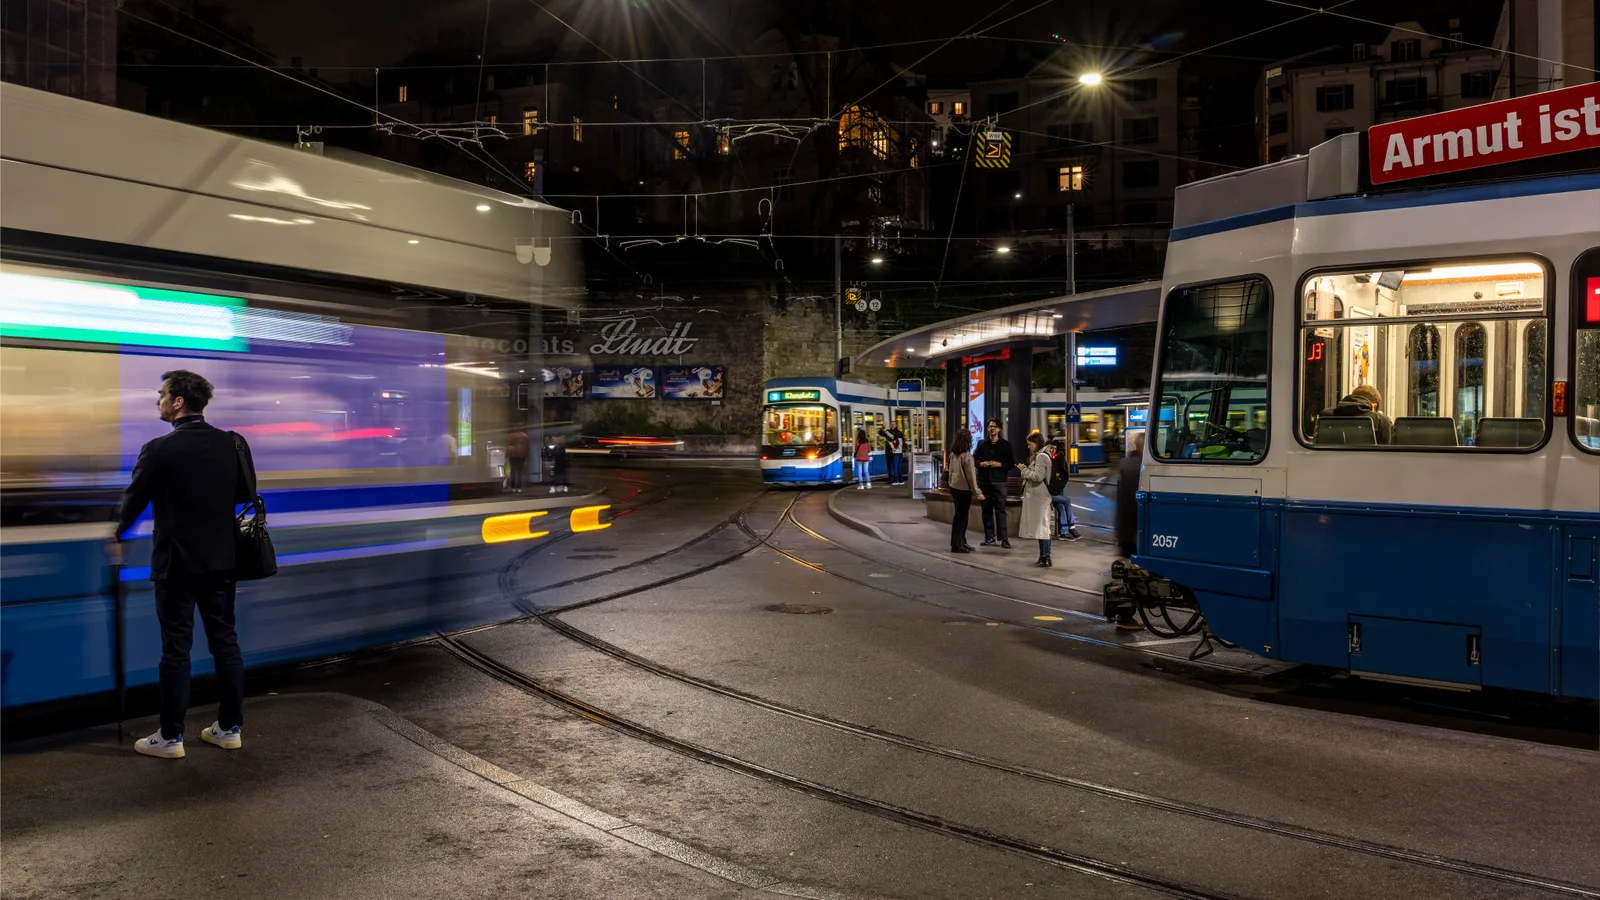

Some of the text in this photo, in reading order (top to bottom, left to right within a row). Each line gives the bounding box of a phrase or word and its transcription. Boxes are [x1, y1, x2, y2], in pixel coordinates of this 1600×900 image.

[1382, 97, 1600, 172] Armut ist
[589, 318, 699, 355] Lindt
[1152, 534, 1179, 548] 2057
